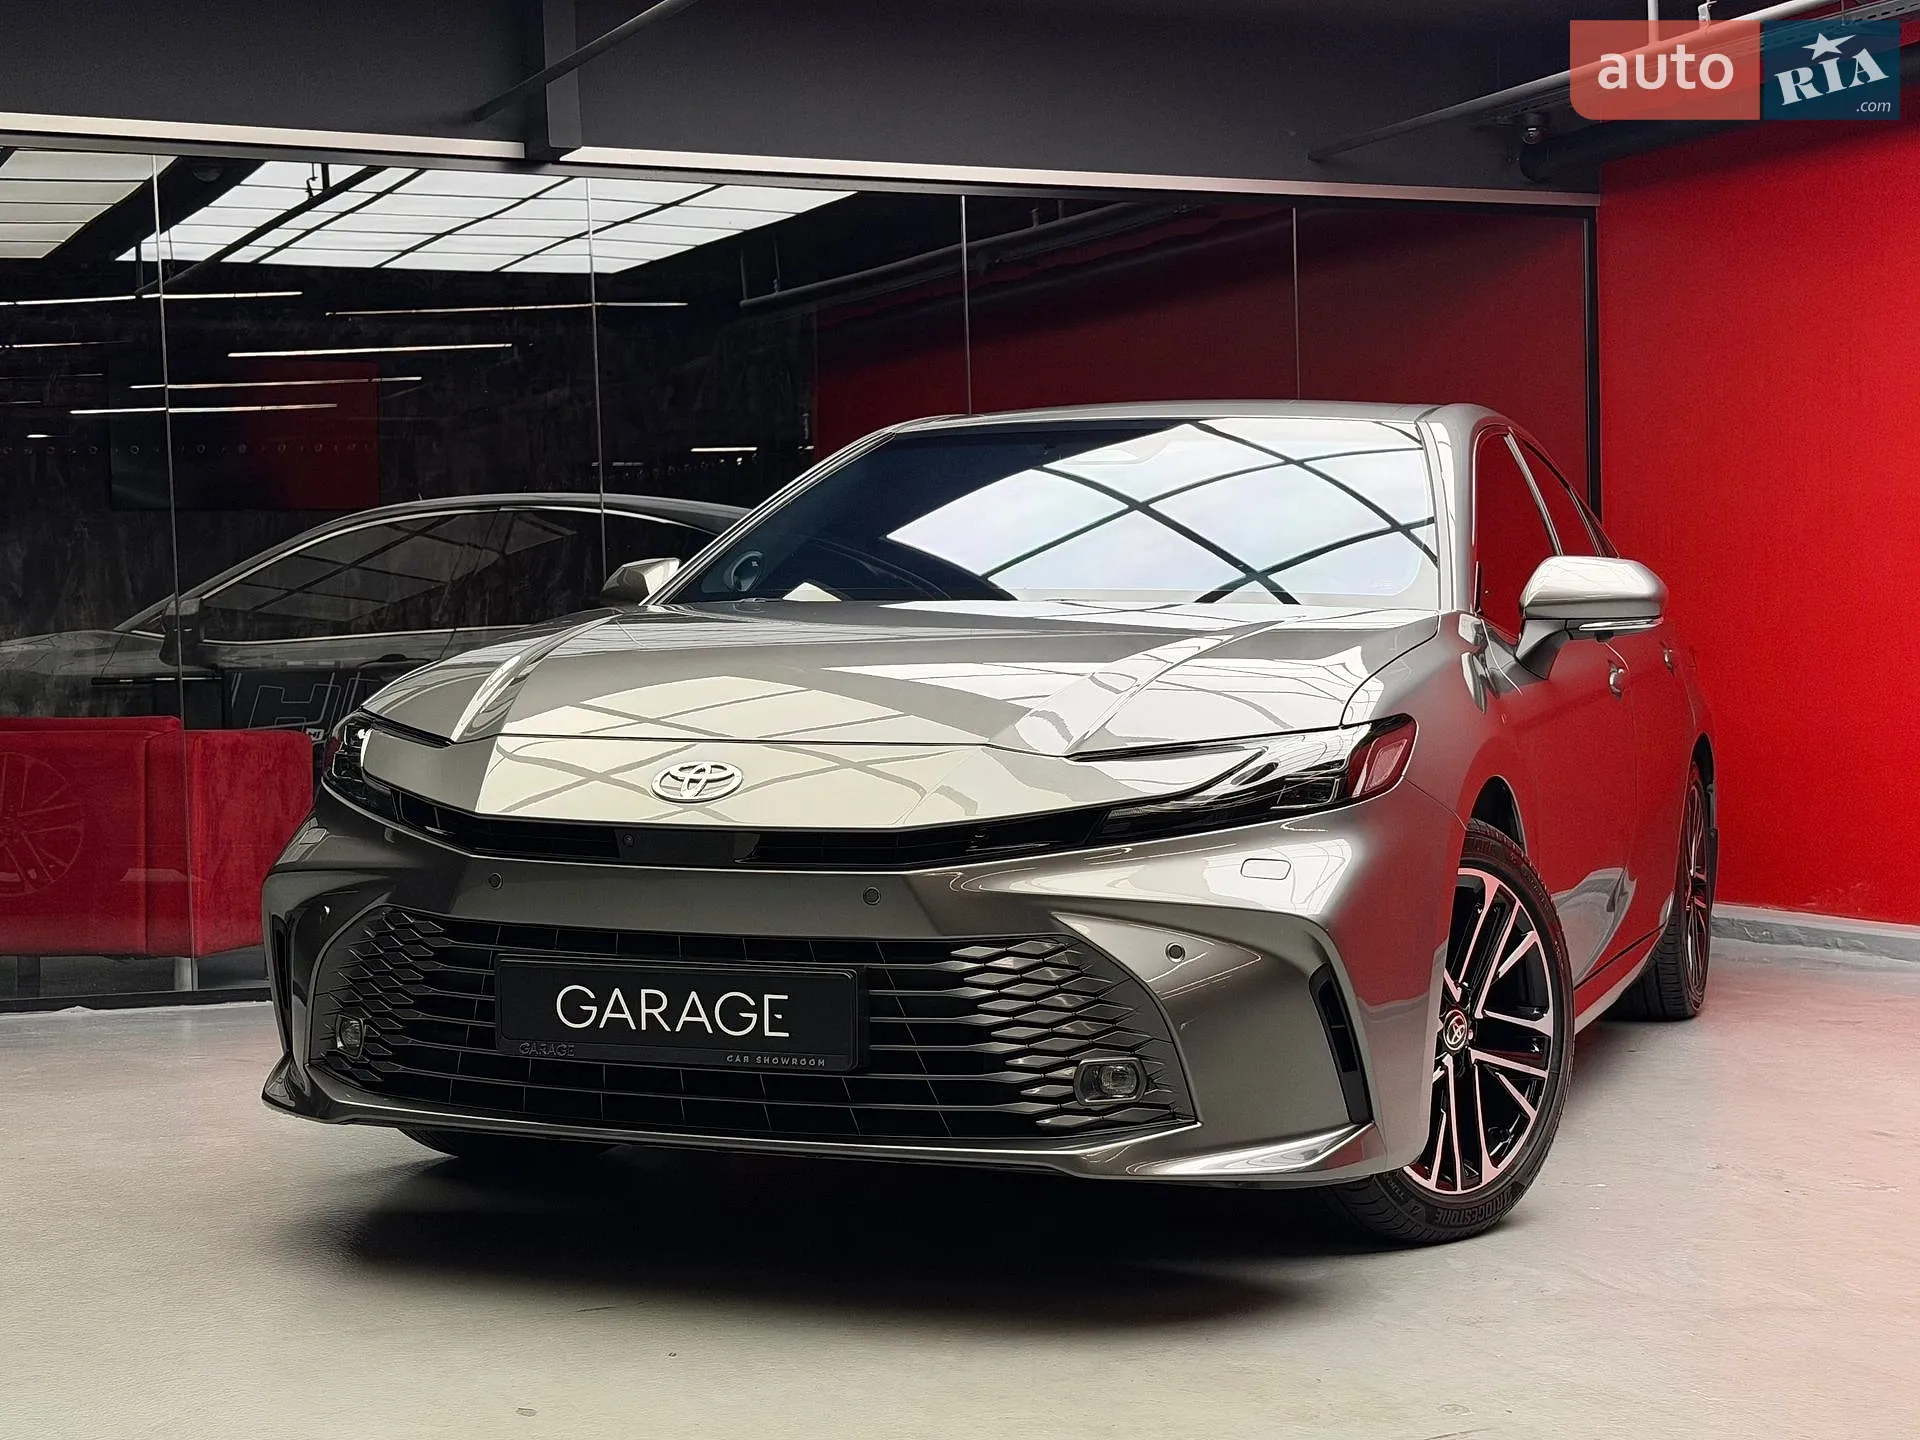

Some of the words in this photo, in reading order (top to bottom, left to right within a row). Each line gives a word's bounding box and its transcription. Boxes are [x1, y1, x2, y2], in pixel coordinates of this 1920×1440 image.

[555, 984, 790, 1038] GARAGE
[519, 1041, 575, 1057] GARAGE
[726, 1054, 749, 1063] CAR
[756, 1055, 825, 1067] SHOWROOM
